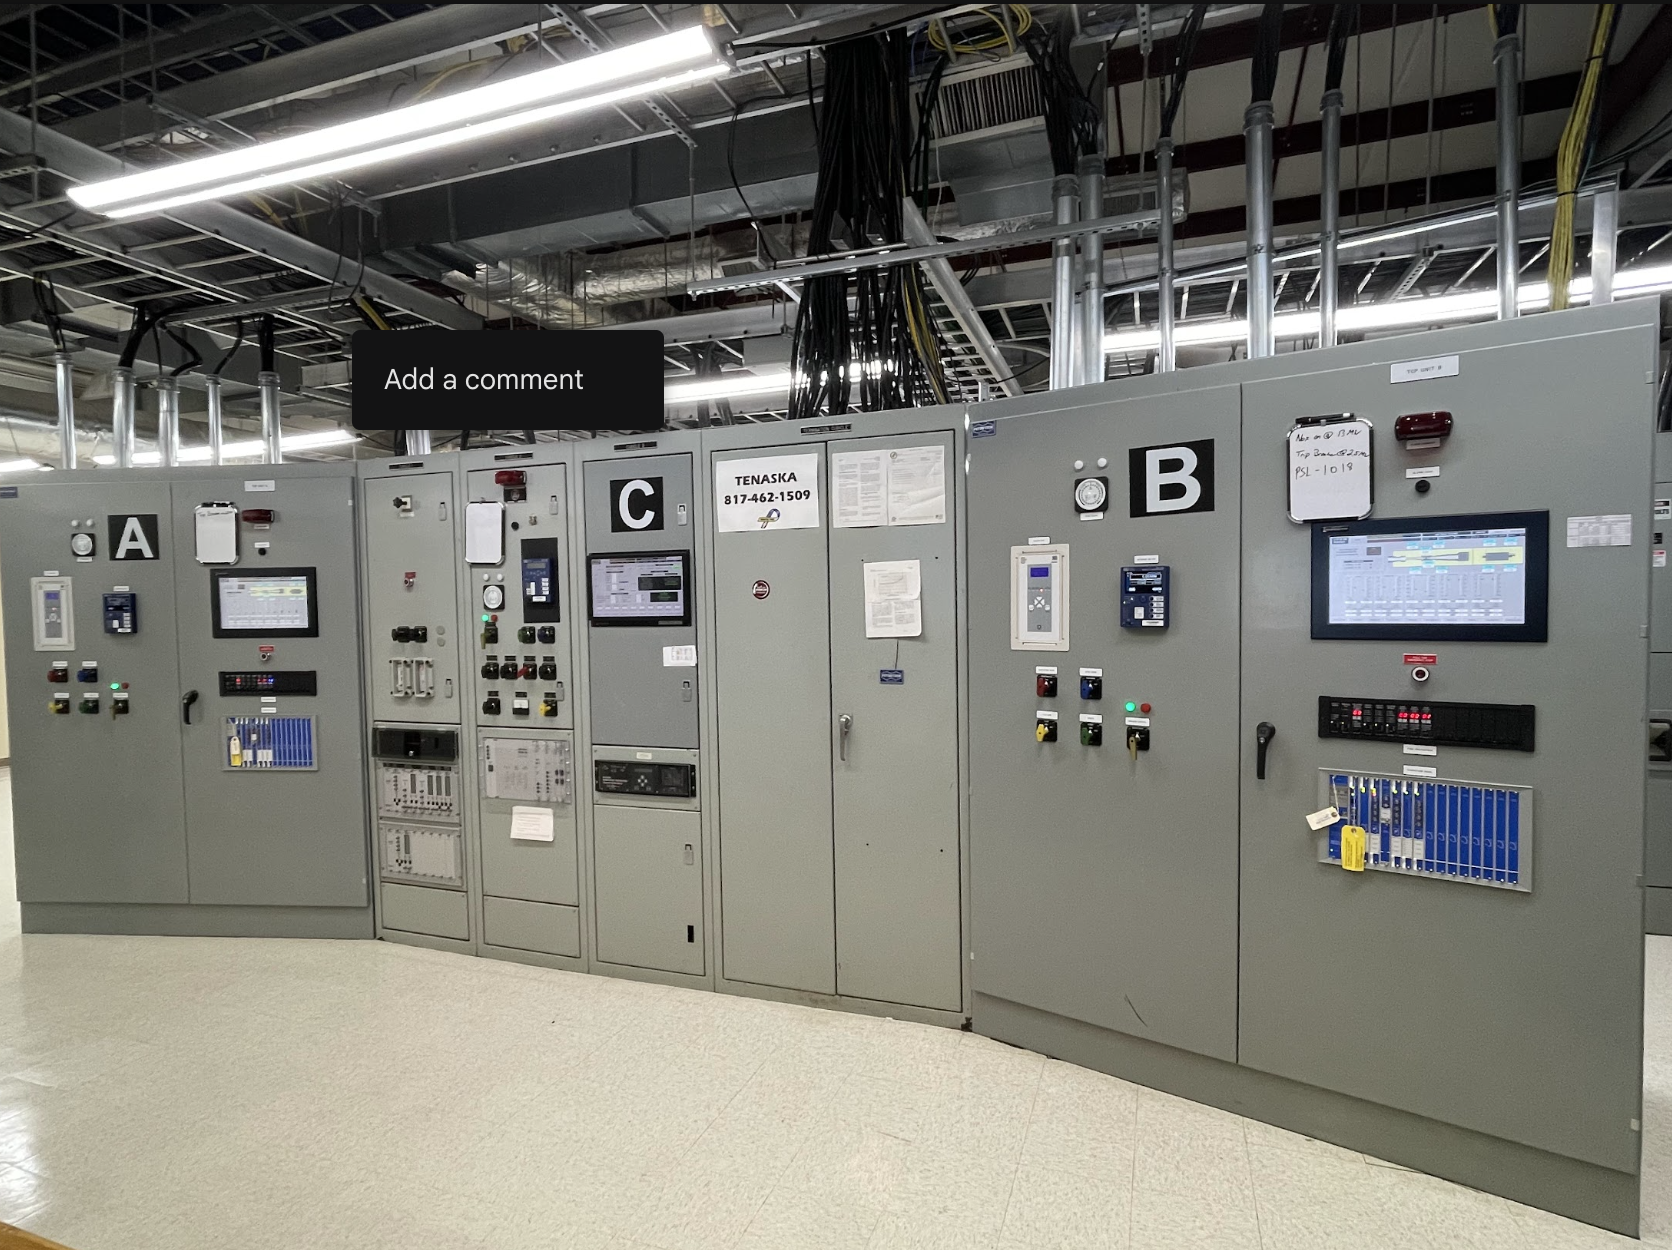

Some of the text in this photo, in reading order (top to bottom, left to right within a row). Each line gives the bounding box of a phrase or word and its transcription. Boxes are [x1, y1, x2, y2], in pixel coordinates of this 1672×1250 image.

[724, 489, 811, 505] 817-462-1509
[734, 472, 798, 486] TENASKA
[1145, 446, 1202, 513] B
[619, 479, 655, 529] C
[115, 517, 154, 559] A
